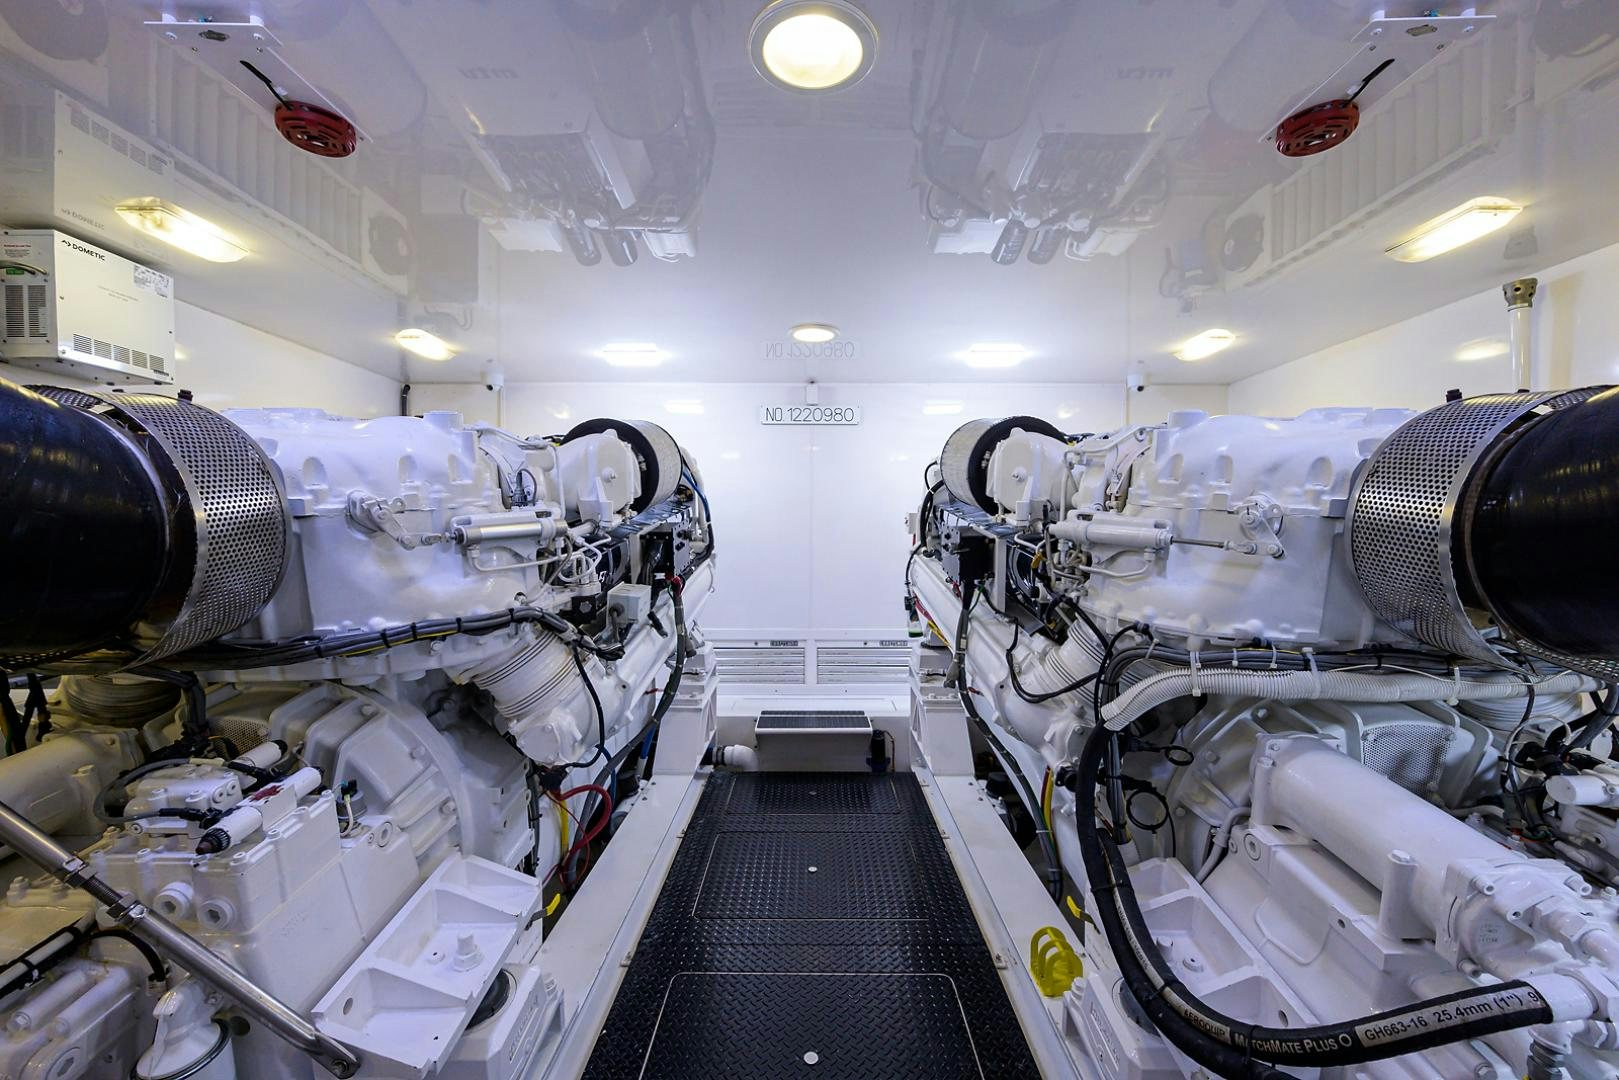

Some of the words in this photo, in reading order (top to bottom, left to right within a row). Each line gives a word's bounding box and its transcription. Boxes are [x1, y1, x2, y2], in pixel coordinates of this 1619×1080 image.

[72, 243, 105, 261] DOMETIC
[1364, 1016, 1428, 1041] GH663-16
[1433, 1001, 1493, 1023] 25.4mm
[1303, 1039, 1338, 1053] PLUS
